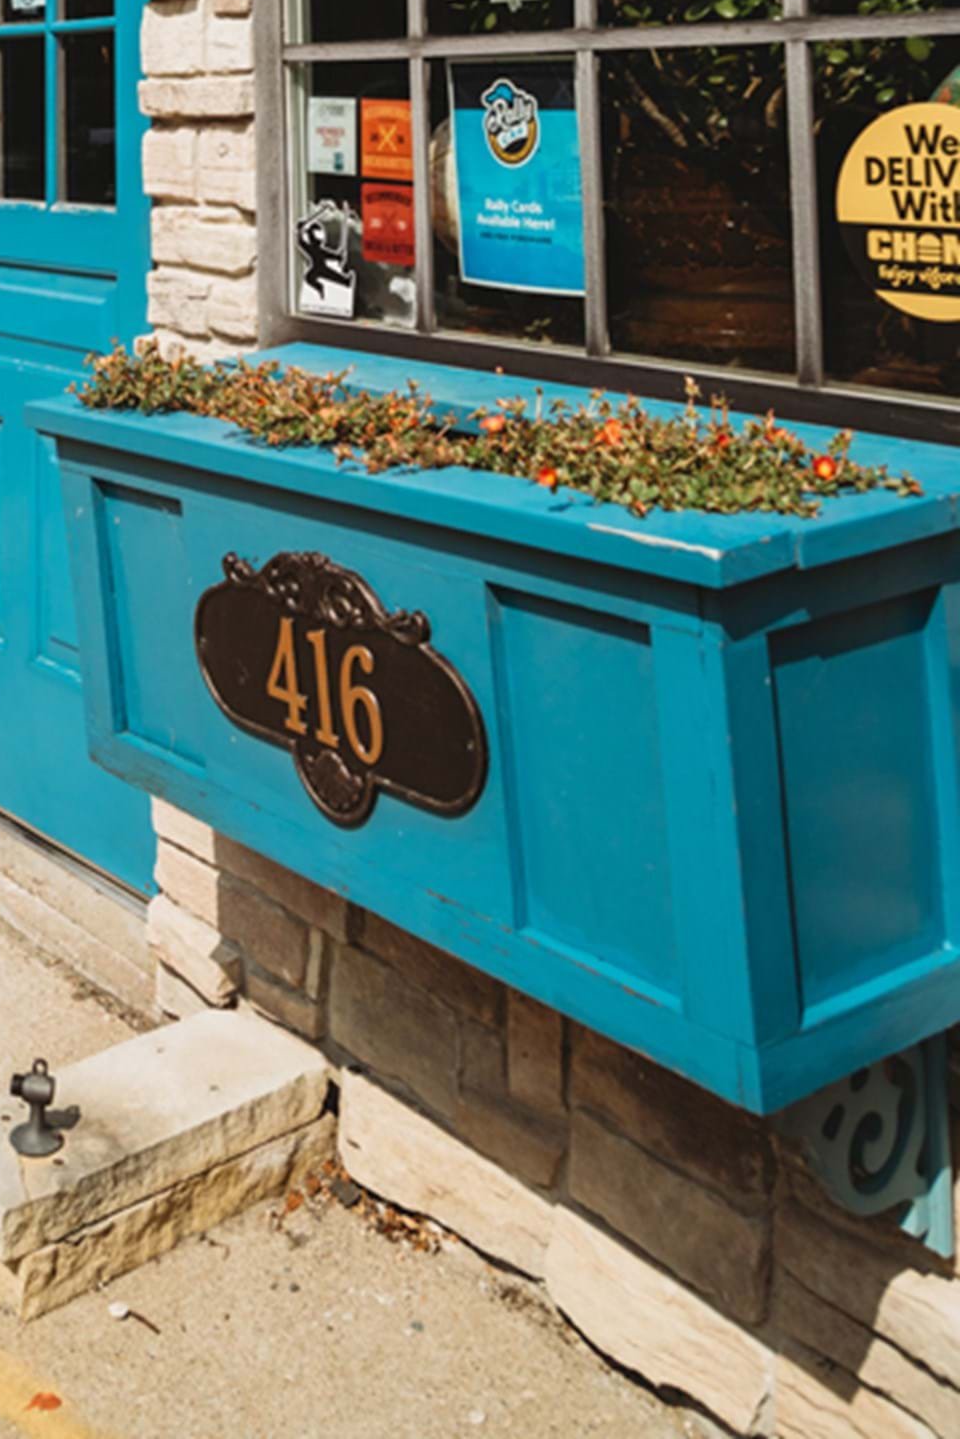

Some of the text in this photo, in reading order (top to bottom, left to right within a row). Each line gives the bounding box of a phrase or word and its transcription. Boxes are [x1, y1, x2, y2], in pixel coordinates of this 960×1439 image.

[903, 124, 960, 156] We
[476, 212, 520, 229] Available
[266, 616, 383, 766] 416
